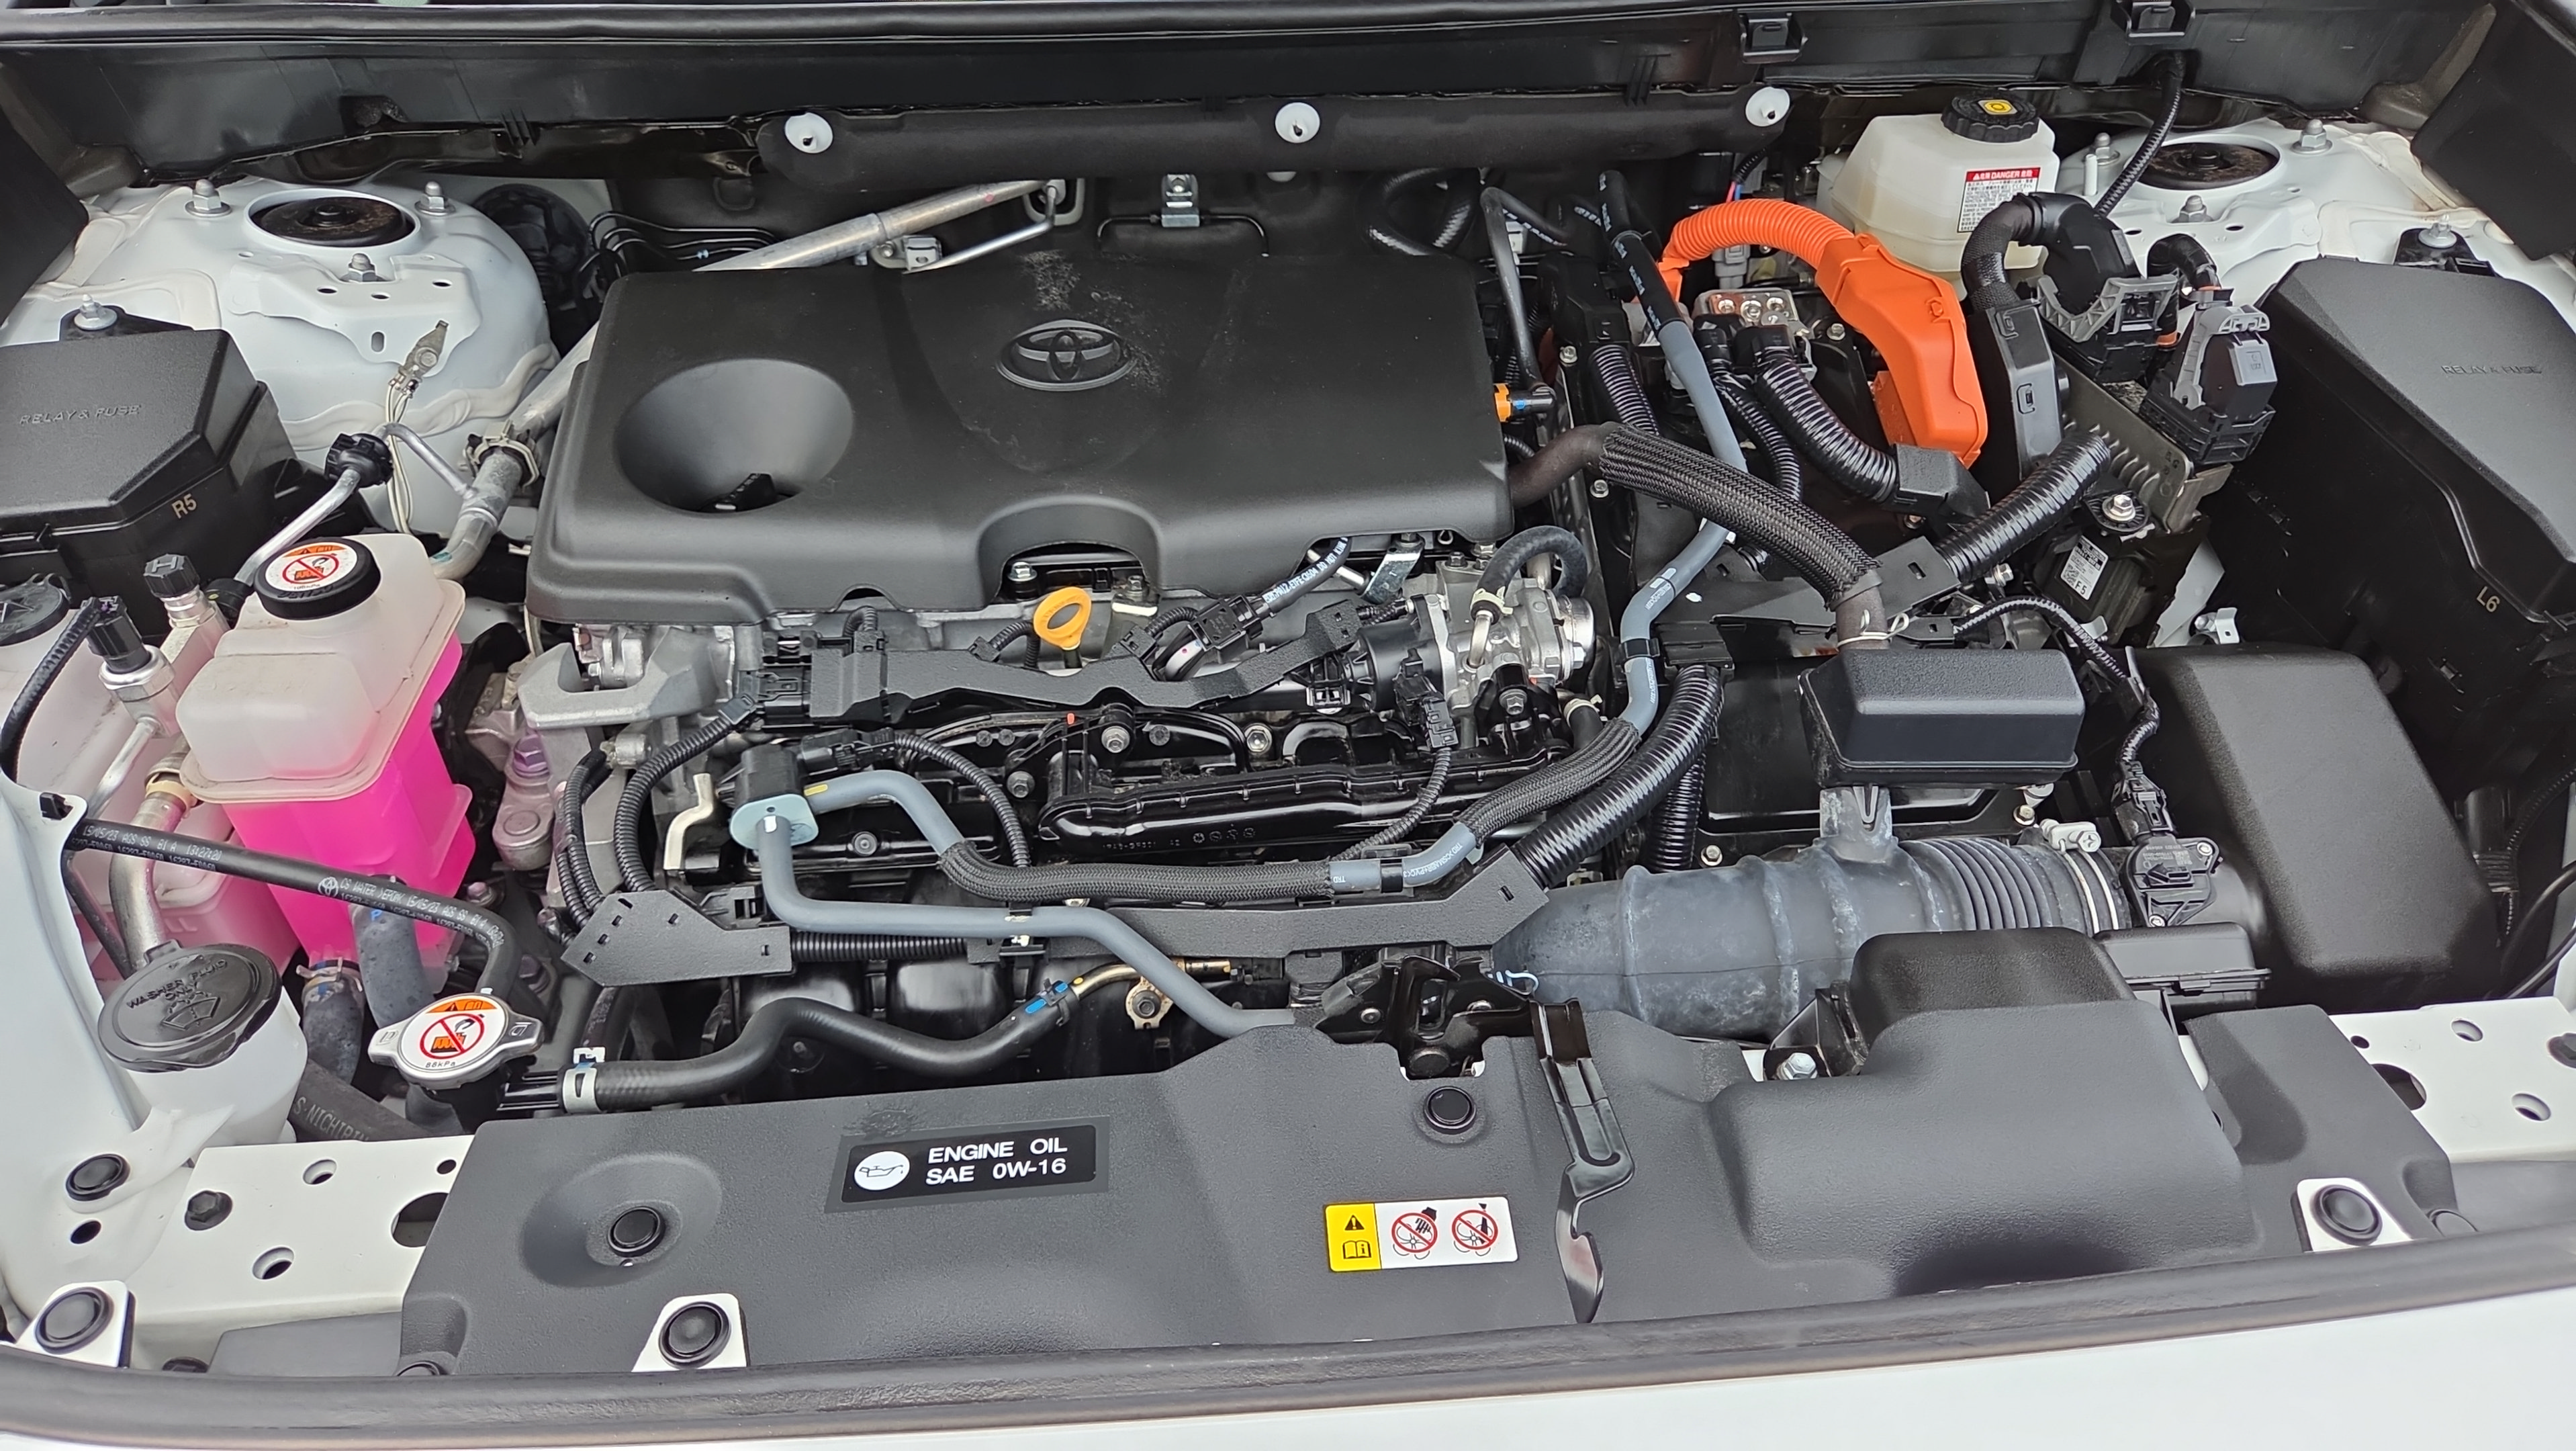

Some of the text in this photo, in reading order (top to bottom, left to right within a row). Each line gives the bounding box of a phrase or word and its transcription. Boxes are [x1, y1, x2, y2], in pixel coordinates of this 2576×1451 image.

[1991, 171, 2020, 179] DANGER
[2441, 365, 2487, 374] RELAY
[2501, 365, 2542, 374] FUSE
[19, 404, 142, 425] RELAY & FUSE
[171, 493, 197, 519] R5
[151, 556, 177, 573] H
[1316, 561, 1328, 572] DO
[1325, 552, 1338, 565] NOT
[2477, 586, 2500, 612] L6
[83, 824, 118, 841] 15/05/23
[353, 881, 377, 896] WATER
[407, 894, 440, 913] 15/05/23
[126, 959, 228, 1009] WASHER FLUID
[165, 981, 198, 1001] ONLY
[928, 1137, 1068, 1163] ENGINE OIL
[925, 1158, 1066, 1185] SAE 0W-16
